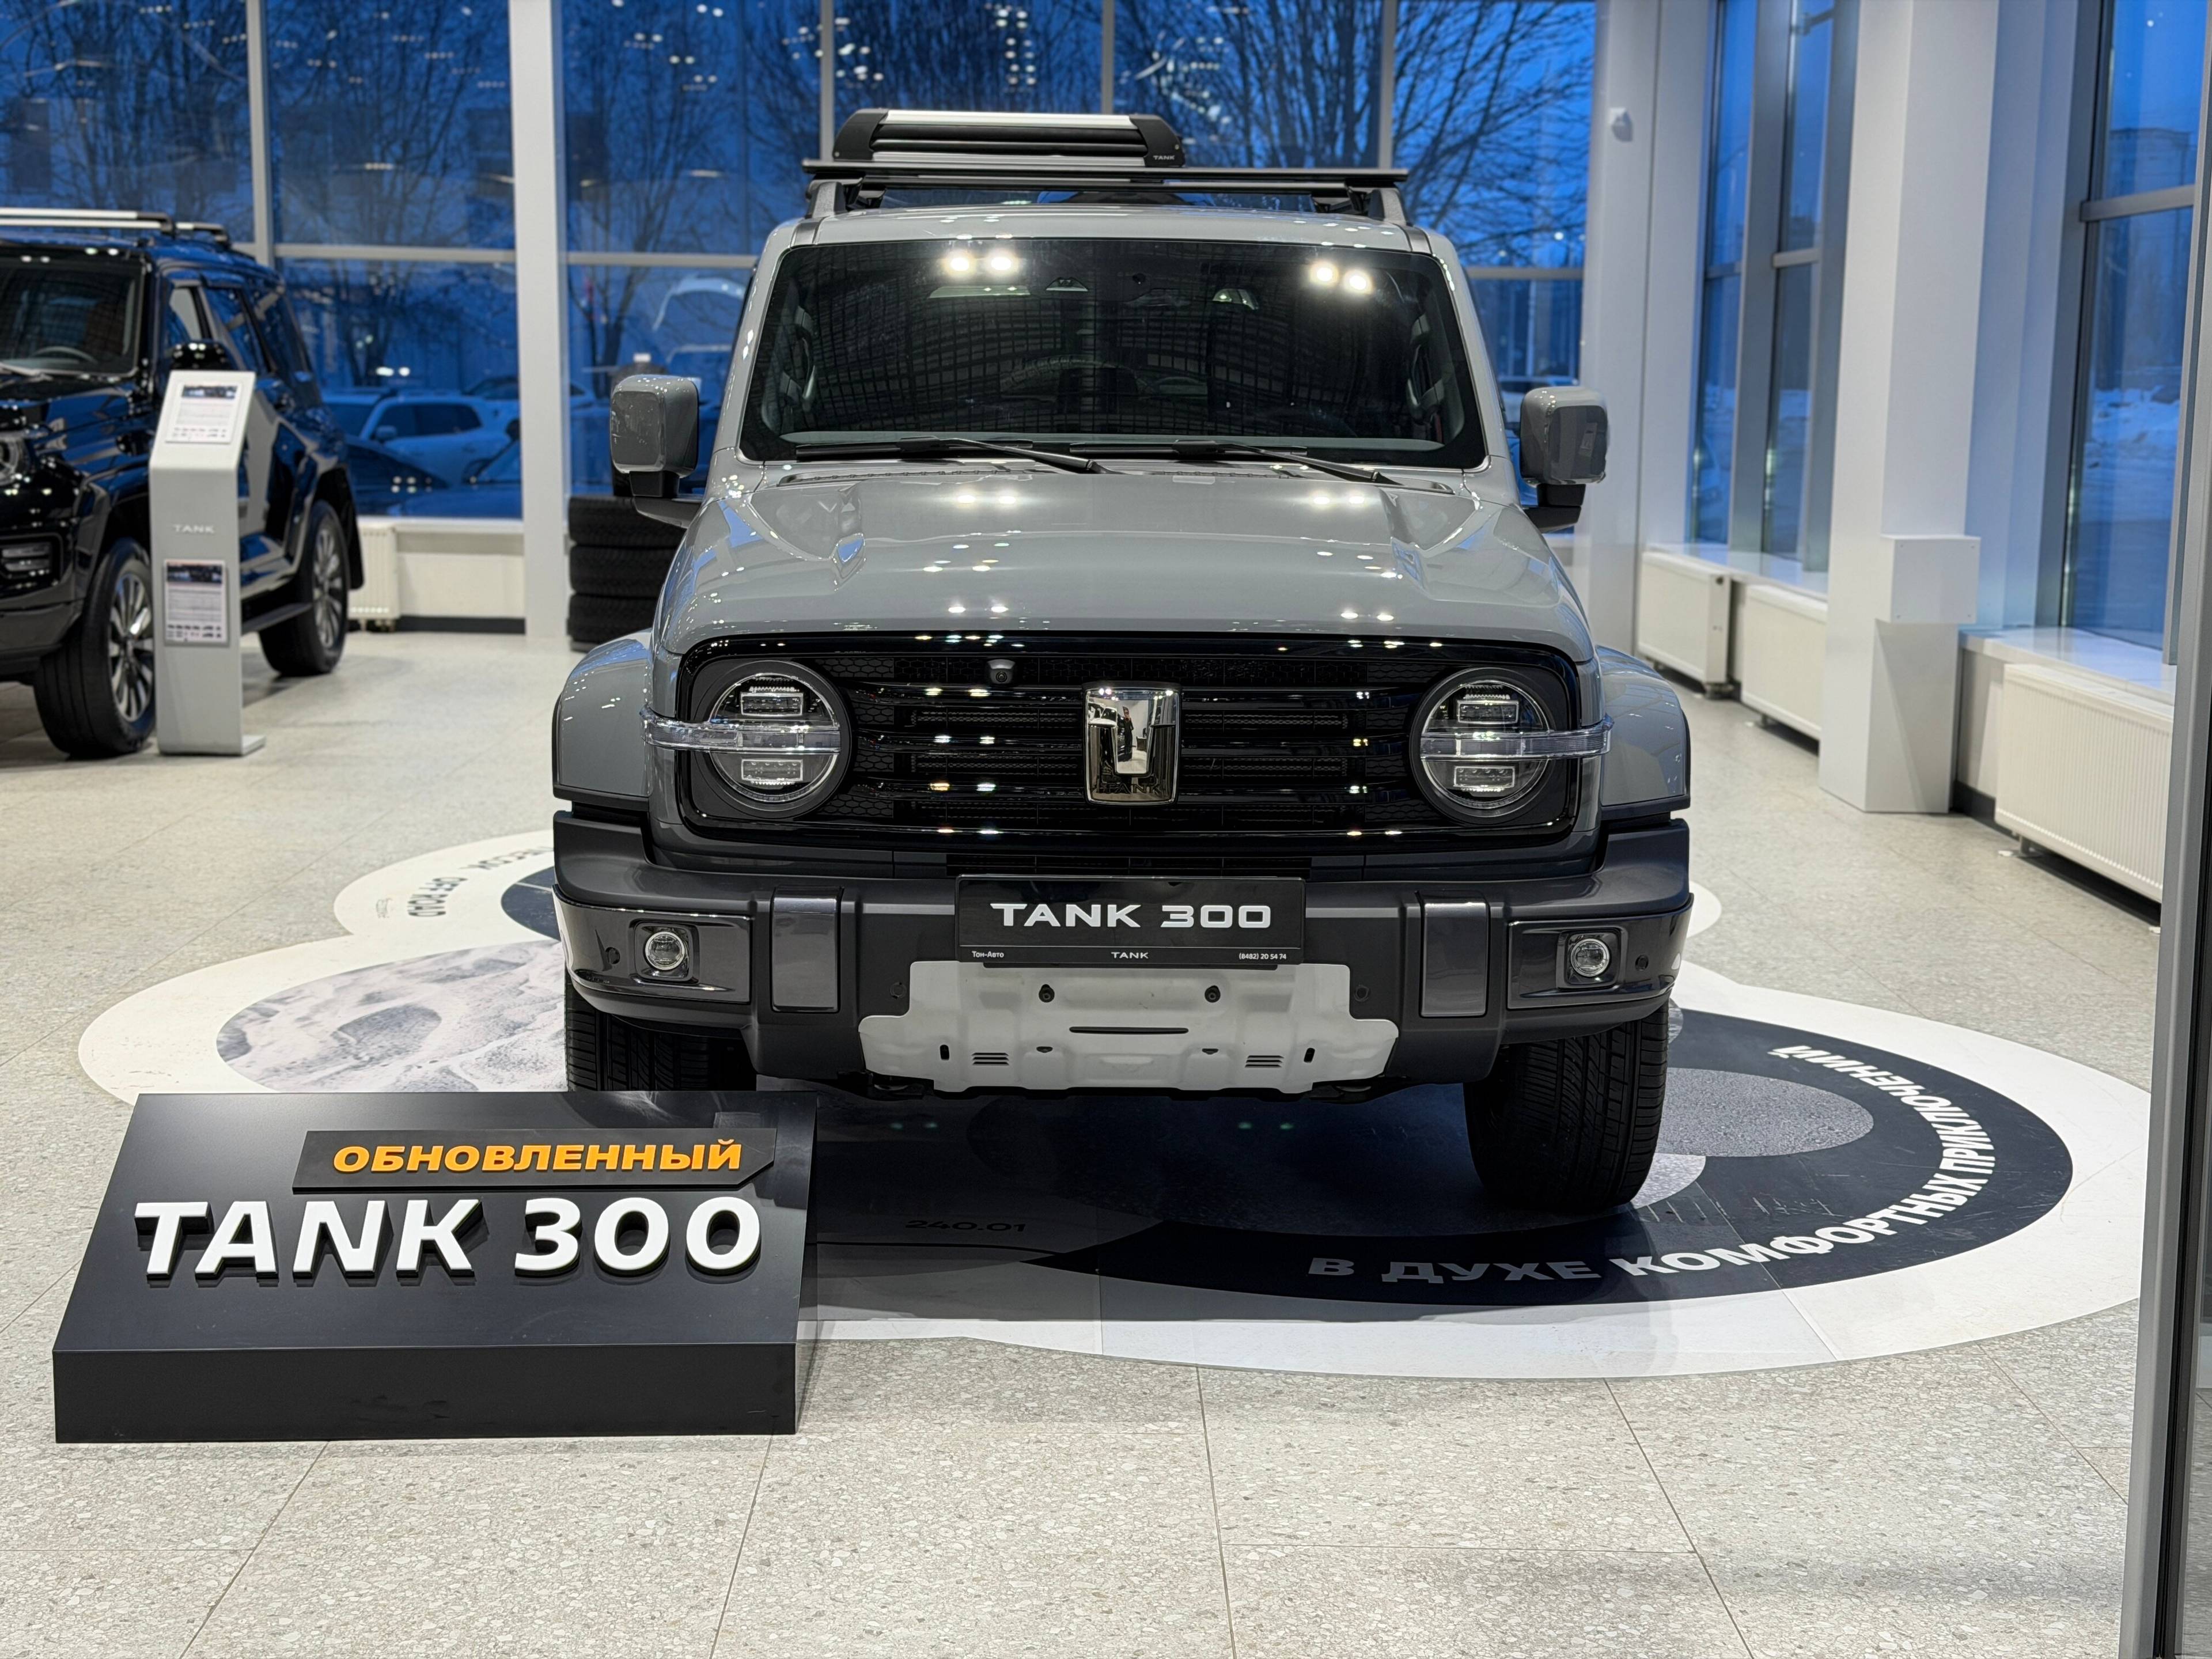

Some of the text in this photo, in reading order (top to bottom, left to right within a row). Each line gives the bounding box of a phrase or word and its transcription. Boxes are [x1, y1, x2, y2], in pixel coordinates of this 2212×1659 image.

[173, 524, 215, 533] TANK
[990, 903, 1271, 929] TANK 300
[972, 950, 1005, 959] Тон-Авто
[334, 1139, 743, 1173] ОБНОВЛЕННЫЙ
[1308, 1045, 1995, 1284] В ДУХЕ КОМФОРТНЫХ ПРИКЛЮЧЕНИЙ
[134, 1196, 760, 1276] TANK 300
[906, 1220, 1026, 1232] 240.01
